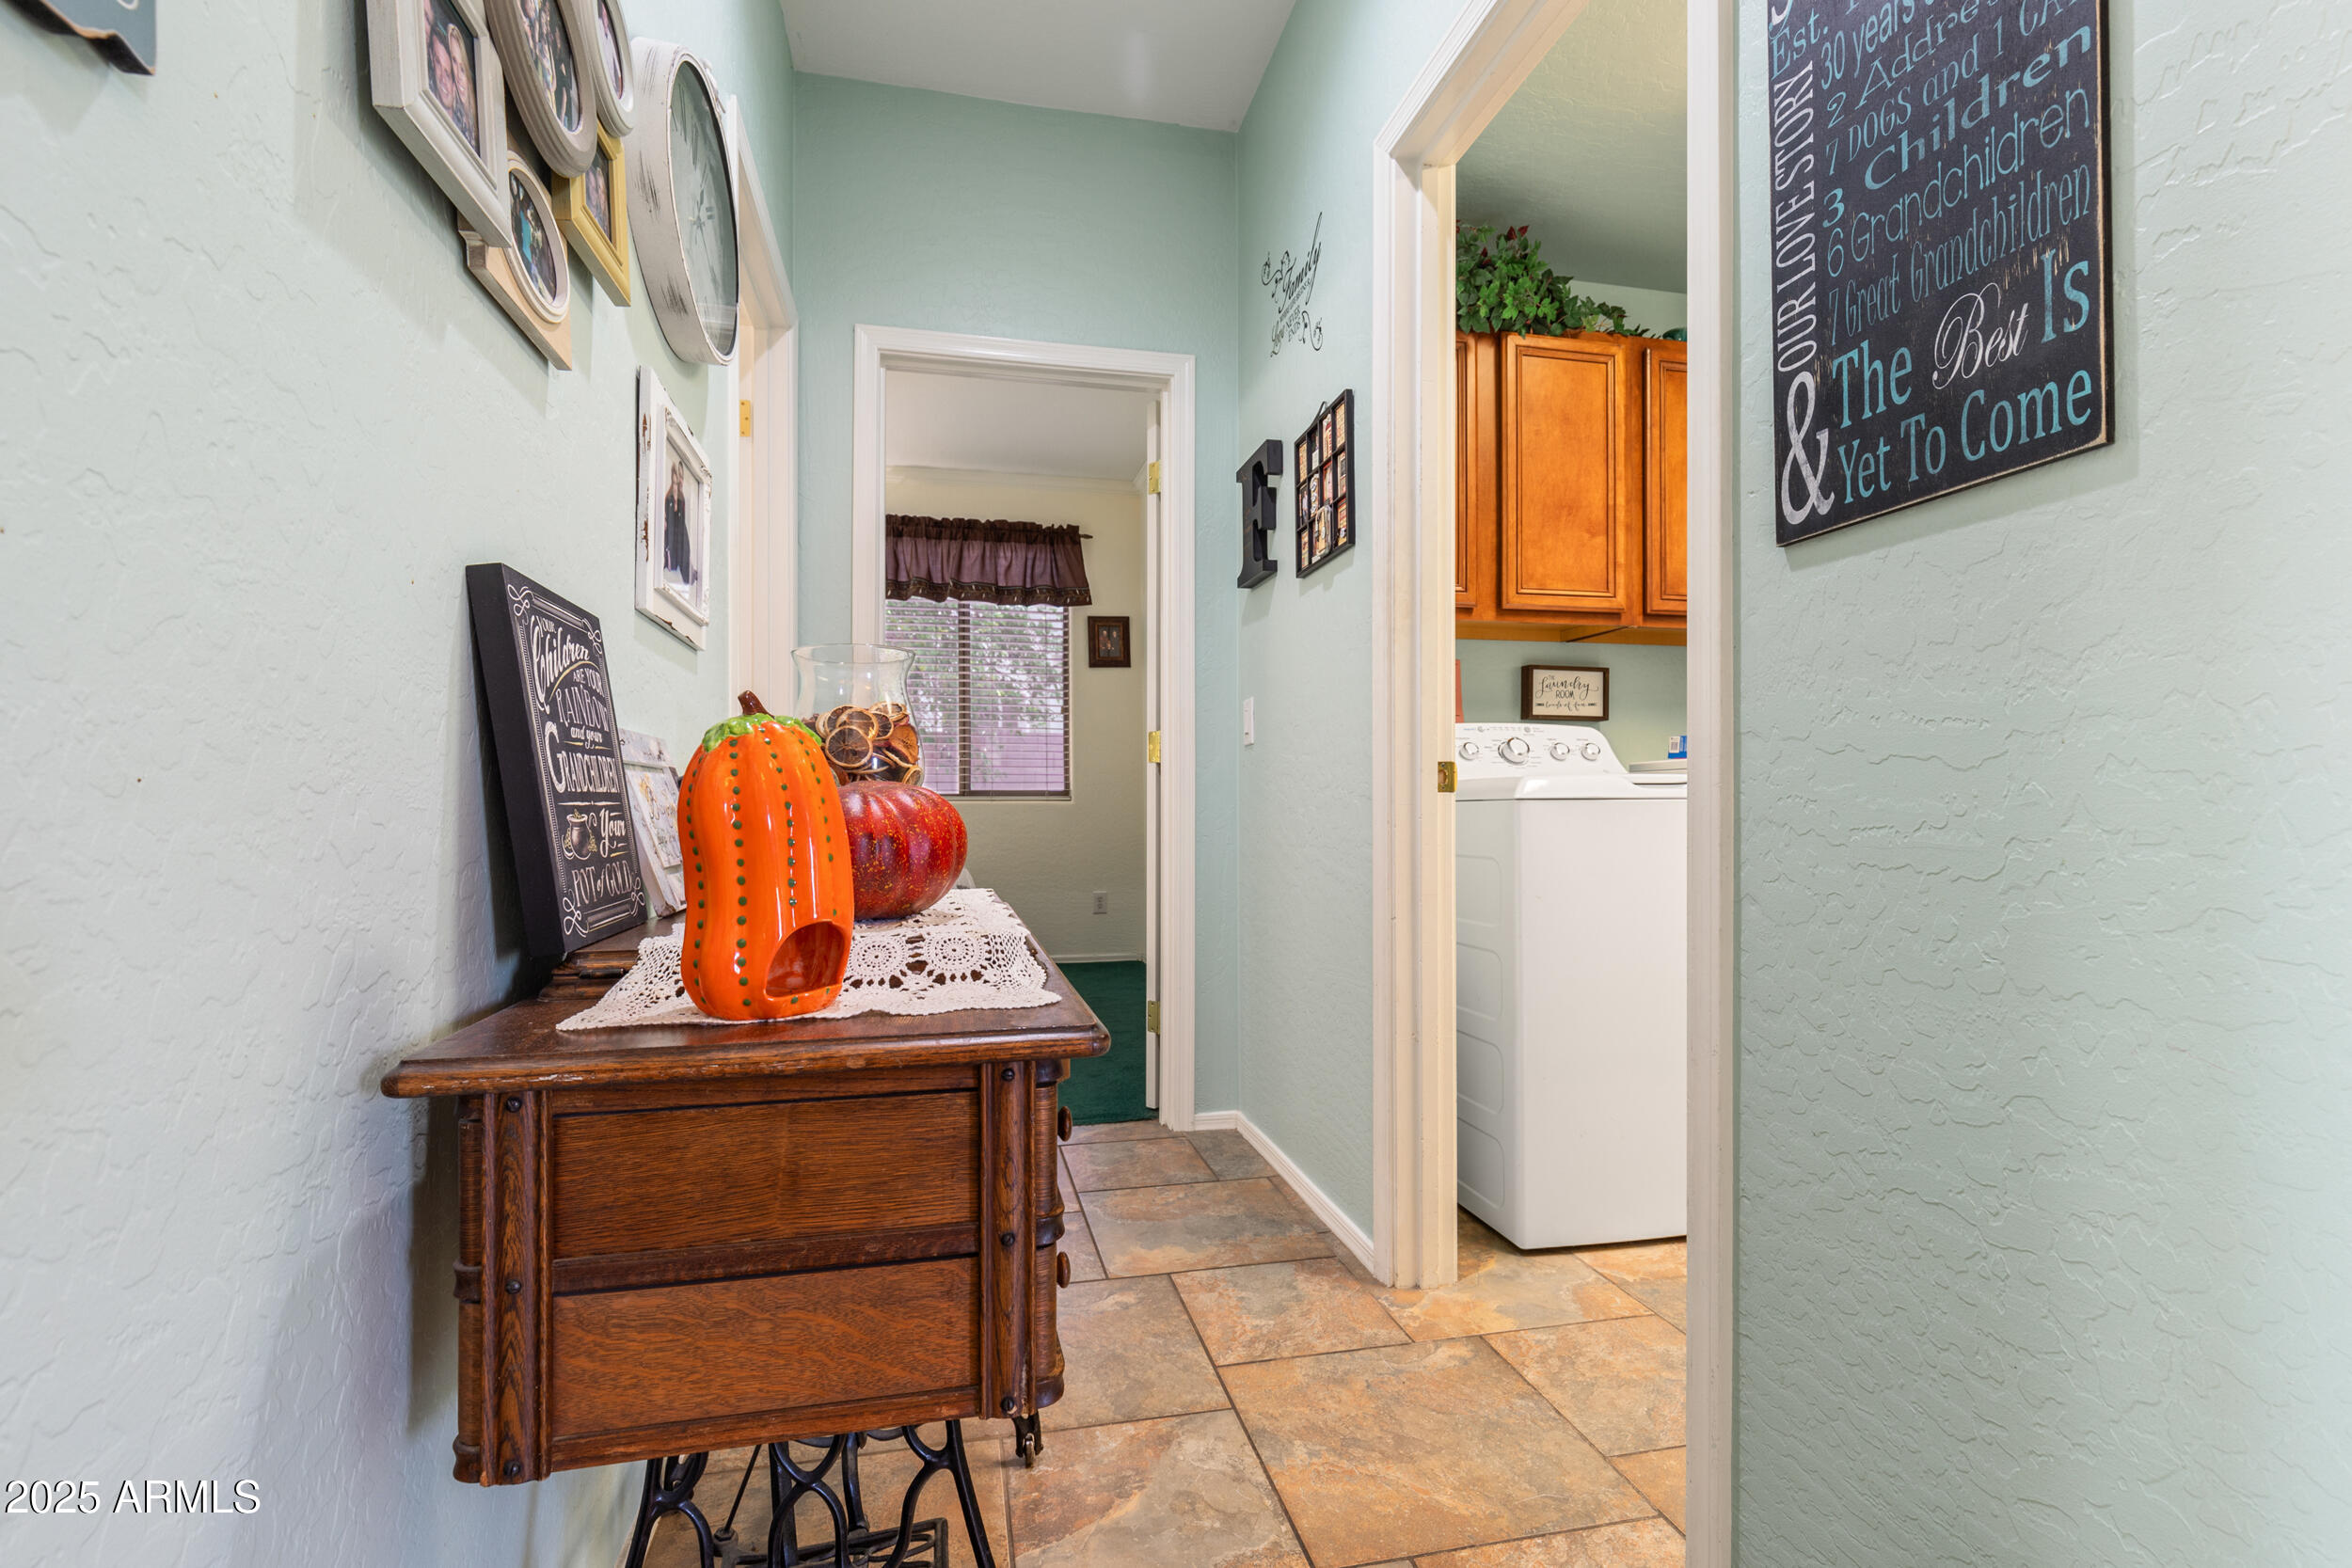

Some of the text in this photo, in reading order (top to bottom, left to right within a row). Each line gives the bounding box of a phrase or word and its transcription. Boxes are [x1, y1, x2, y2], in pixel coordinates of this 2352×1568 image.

[1771, 8, 1828, 81] Est.
[1821, 31, 1846, 90] 30
[1852, 0, 1915, 78] years
[1826, 0, 2074, 176] 7 DOGS and 1 CA
[1827, 91, 1847, 129] 2
[1855, 0, 2000, 110] Addre
[1773, 60, 1815, 191] STORY
[1822, 24, 2091, 228] 3 Children
[1827, 88, 2090, 277] 6 Grandchildren
[1279, 212, 1323, 313] Family
[1775, 180, 1817, 294] LOVE
[1828, 164, 2090, 346] 7 Great Grandchildren
[1777, 281, 1818, 372] OUR
[1832, 249, 2090, 430] The Best Is
[1781, 371, 1836, 525] &
[1837, 370, 2092, 504] Yet To Come
[531, 615, 590, 715] Children
[555, 686, 610, 733] RAINBOW
[584, 668, 604, 698] YOUR
[1555, 689, 1576, 701] ROOM
[545, 721, 621, 794] GRANDCHILDREN
[570, 725, 603, 749] and your
[599, 808, 627, 858] Your
[572, 860, 633, 908] POT of GOLD
